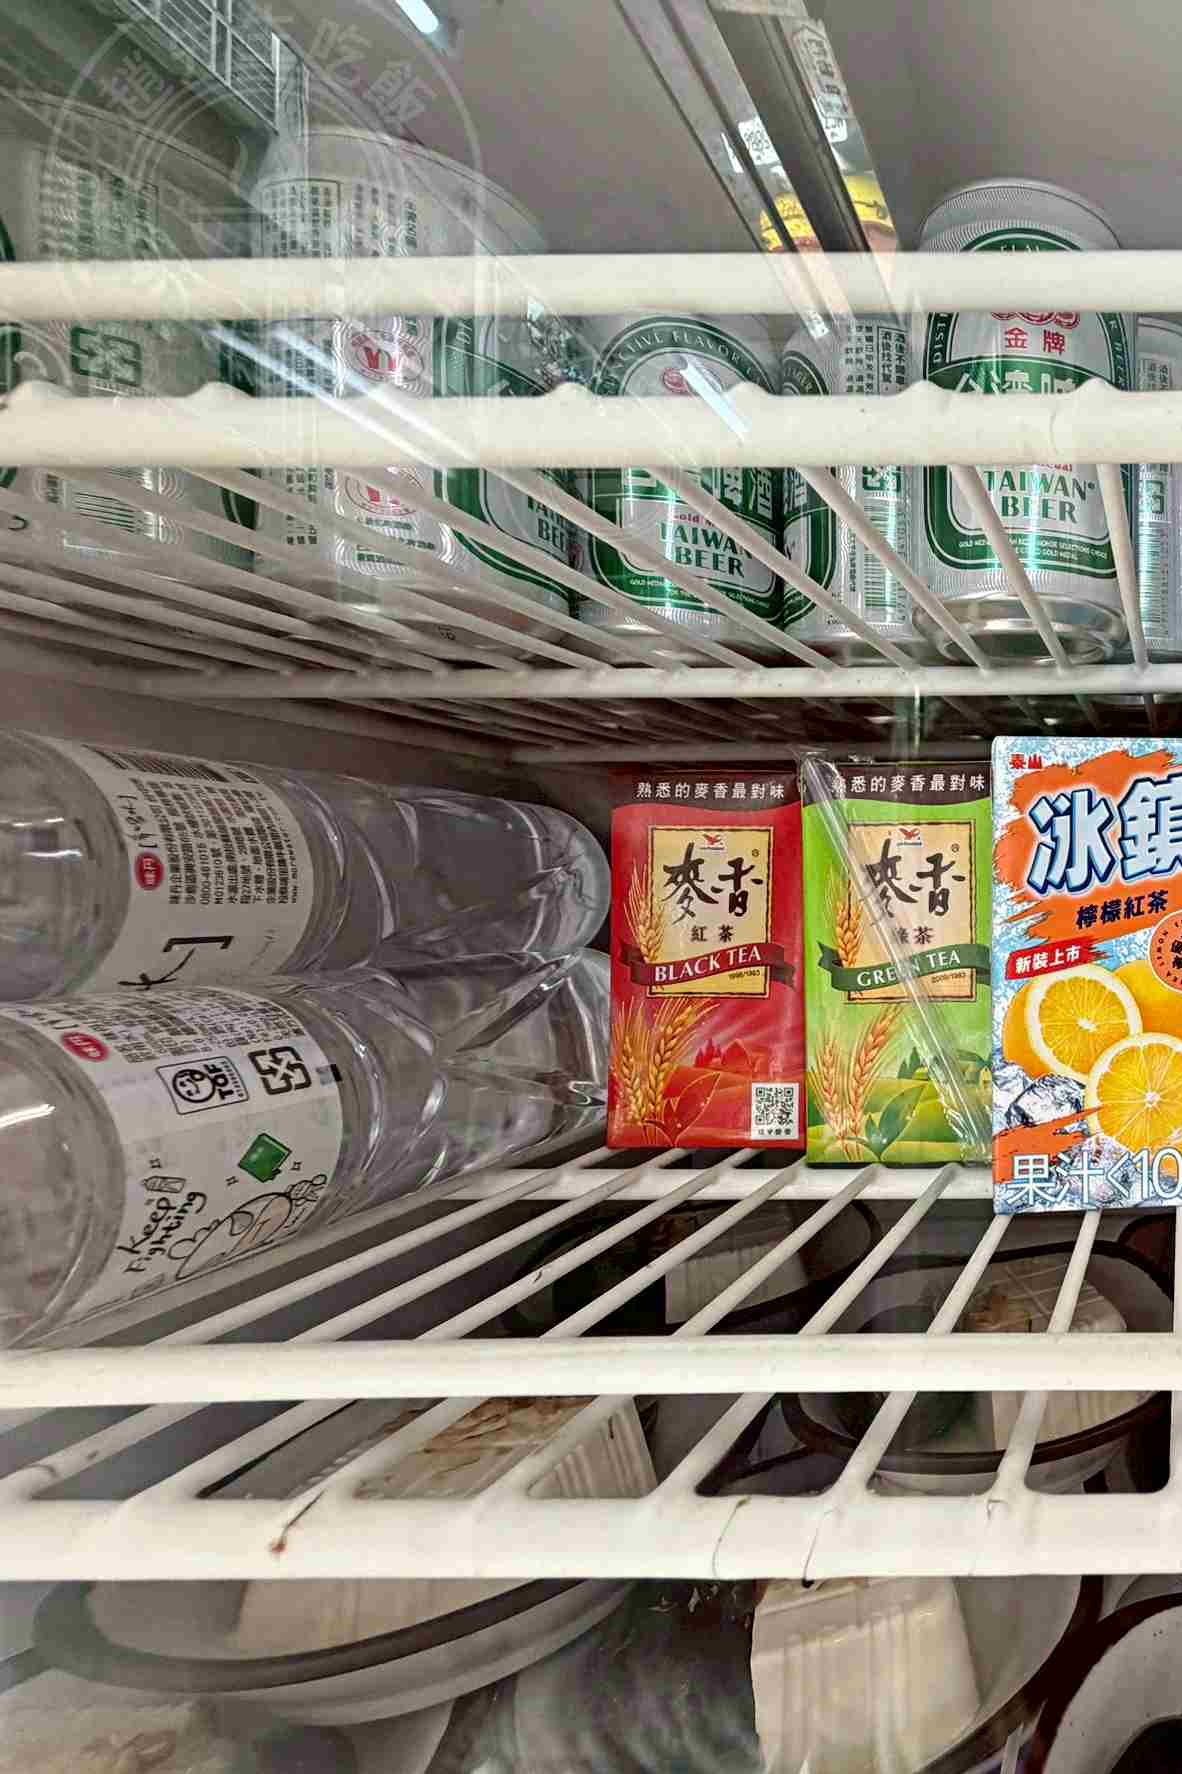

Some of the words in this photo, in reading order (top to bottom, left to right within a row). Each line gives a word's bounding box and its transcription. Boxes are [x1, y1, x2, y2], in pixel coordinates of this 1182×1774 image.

[1004, 327, 1066, 355] 金牌
[983, 470, 1088, 501] TAIWAN
[1001, 495, 1077, 524] BEER
[674, 546, 745, 578] BEER
[1009, 753, 1043, 770] 泰山
[636, 782, 785, 800] 熟悉的麥香最對味
[1076, 890, 1169, 930] 檸檬紅茶
[690, 924, 735, 943] 紅茶
[655, 952, 721, 983] BLACK
[727, 946, 762, 966] TEA
[856, 957, 921, 987] GREN
[926, 949, 961, 969] TEA
[1015, 944, 1081, 974] 新裝上市
[117, 1197, 177, 1254] Keep
[123, 1191, 207, 1273] Fighting
